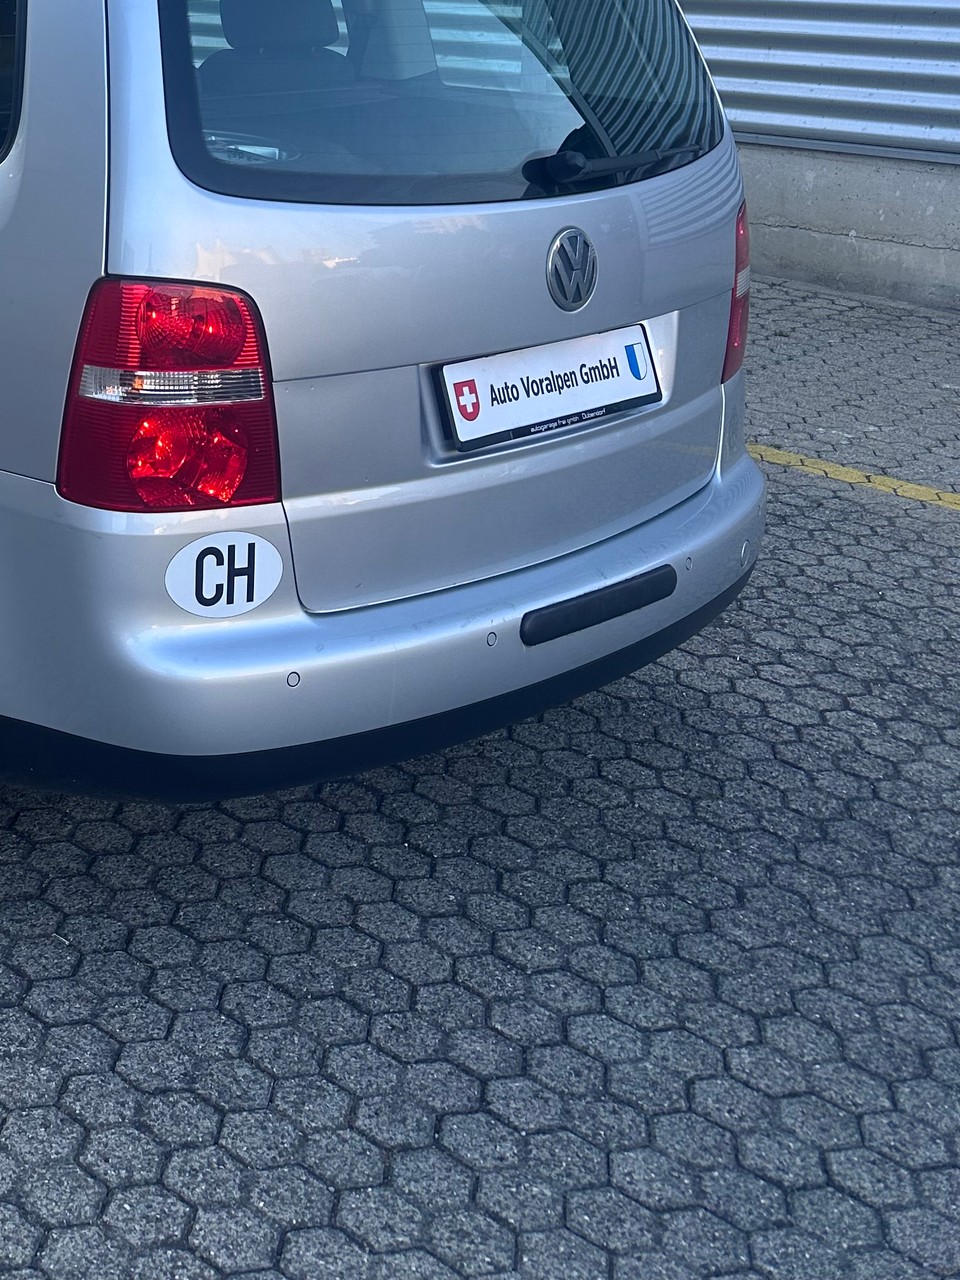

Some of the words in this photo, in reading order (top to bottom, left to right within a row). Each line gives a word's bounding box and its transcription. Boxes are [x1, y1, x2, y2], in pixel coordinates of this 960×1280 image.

[550, 229, 595, 308] VW
[489, 381, 520, 407] Auto
[520, 370, 579, 398] Voralpen
[580, 356, 621, 385] GmbH
[195, 542, 256, 607] CH
